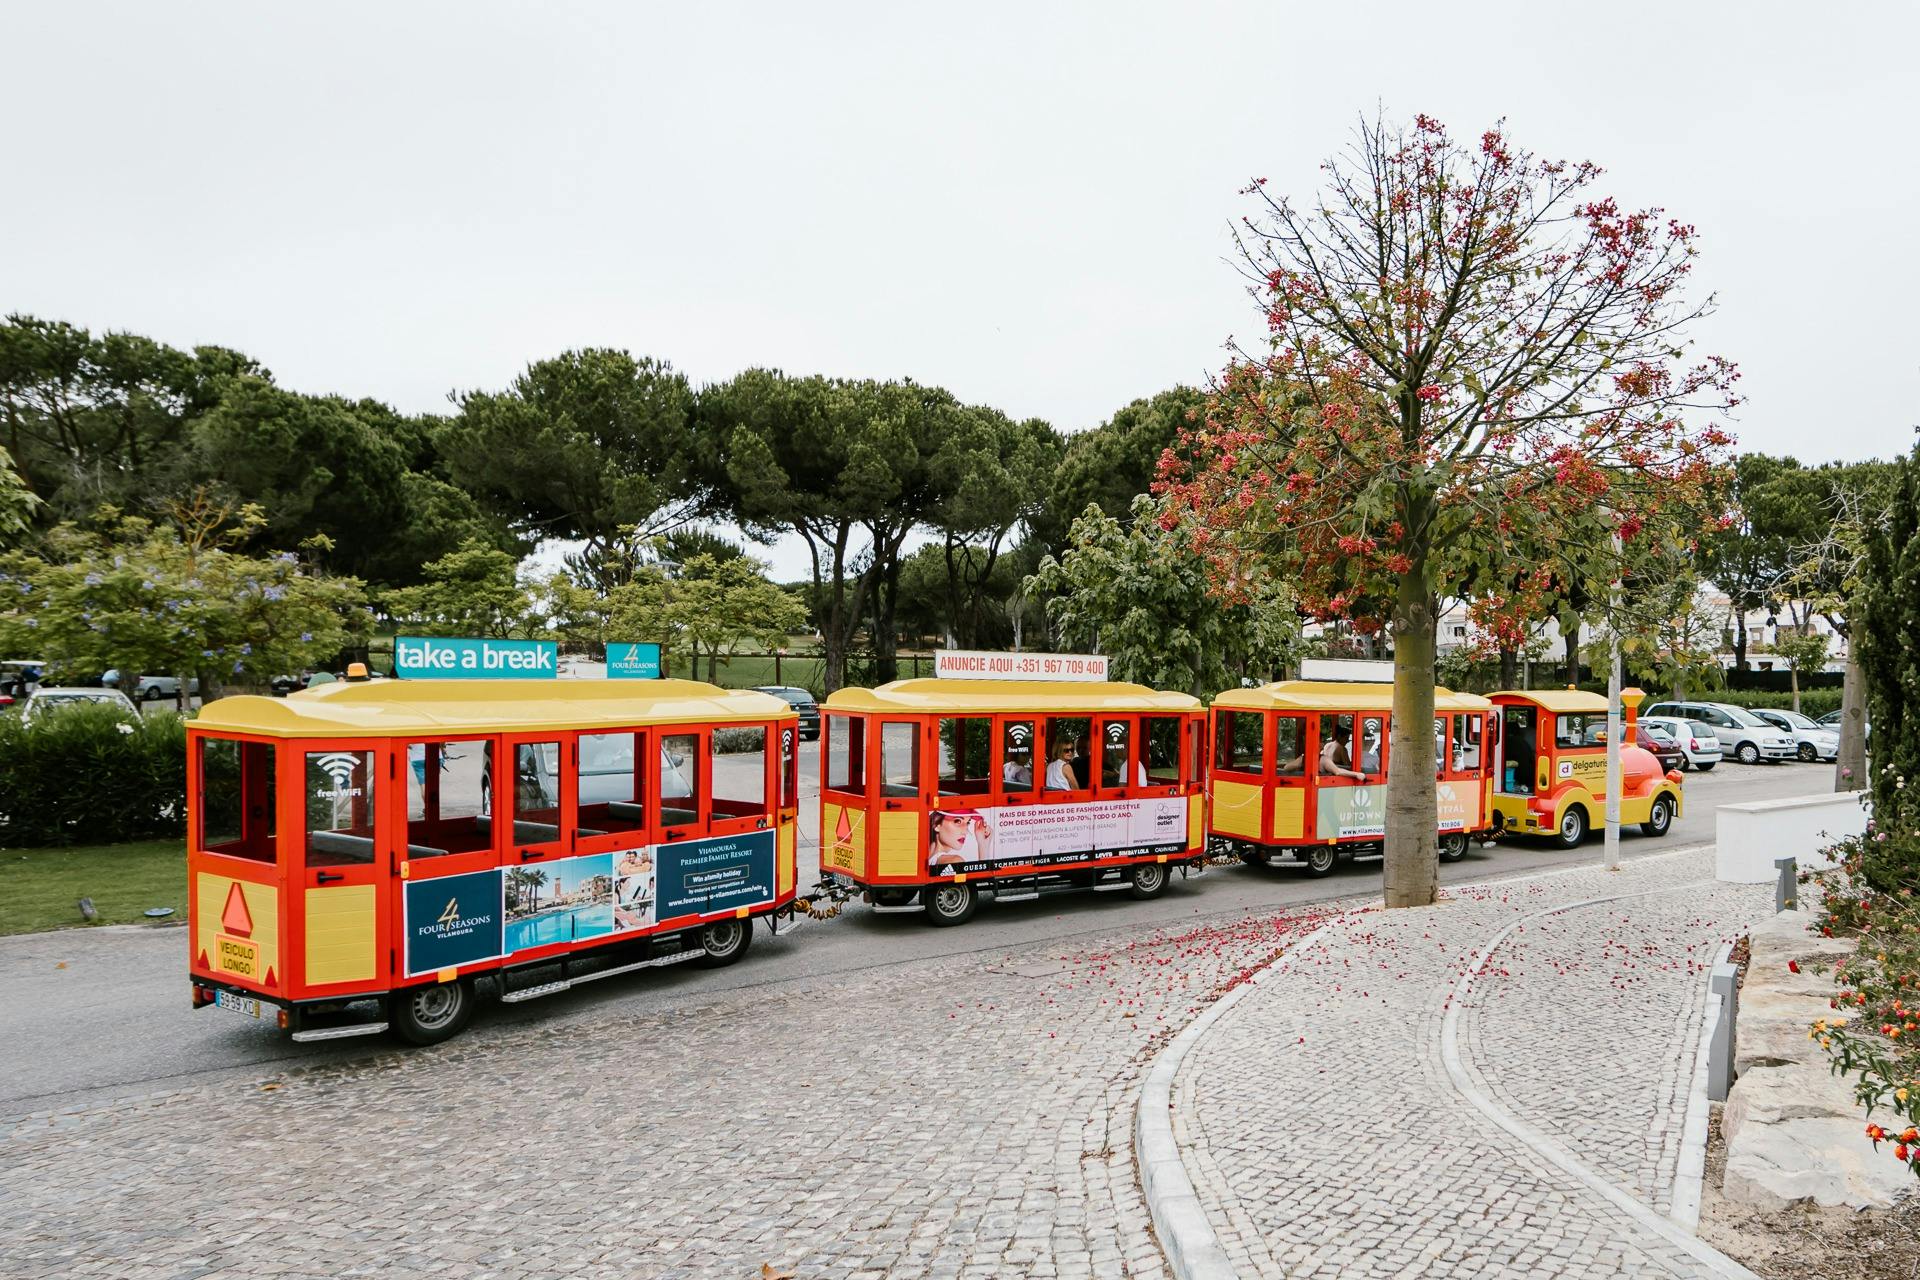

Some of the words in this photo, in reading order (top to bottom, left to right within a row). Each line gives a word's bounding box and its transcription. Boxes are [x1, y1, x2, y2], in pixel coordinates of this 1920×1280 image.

[397, 641, 456, 669] take
[461, 649, 477, 669] a
[483, 643, 552, 670] break
[940, 656, 986, 671] ANUNCIE
[989, 658, 1013, 672] AQUI
[1016, 659, 1040, 673] +351
[1044, 660, 1062, 673] 967
[1066, 660, 1084, 674] 709
[1086, 661, 1104, 675] 400
[1572, 759, 1608, 771] delgaturis
[317, 789, 338, 798] free
[1038, 808, 1065, 816] MARCAS
[1076, 804, 1103, 813] FASHION
[1110, 803, 1141, 811] LIFESTYLE
[999, 820, 1014, 828] COM
[1016, 817, 1055, 826] DESCONTOS
[1157, 814, 1180, 822] designer
[1339, 811, 1382, 822] UPTOWN
[698, 843, 737, 855] VILAMOURA'S
[680, 855, 709, 866] PREMIER
[708, 852, 730, 862] FAMILY
[730, 849, 753, 858] RESORT
[1025, 857, 1050, 865] HILFIGER
[1056, 855, 1079, 863] LACOSTE
[963, 863, 987, 872] GUESS
[723, 869, 742, 880] holiday
[437, 897, 460, 932] 4
[418, 923, 446, 936] FOUR
[450, 914, 491, 930] SEASONS
[436, 927, 474, 939] VILAMOURA
[220, 940, 254, 960] VEICULO
[223, 958, 251, 975] LONGO
